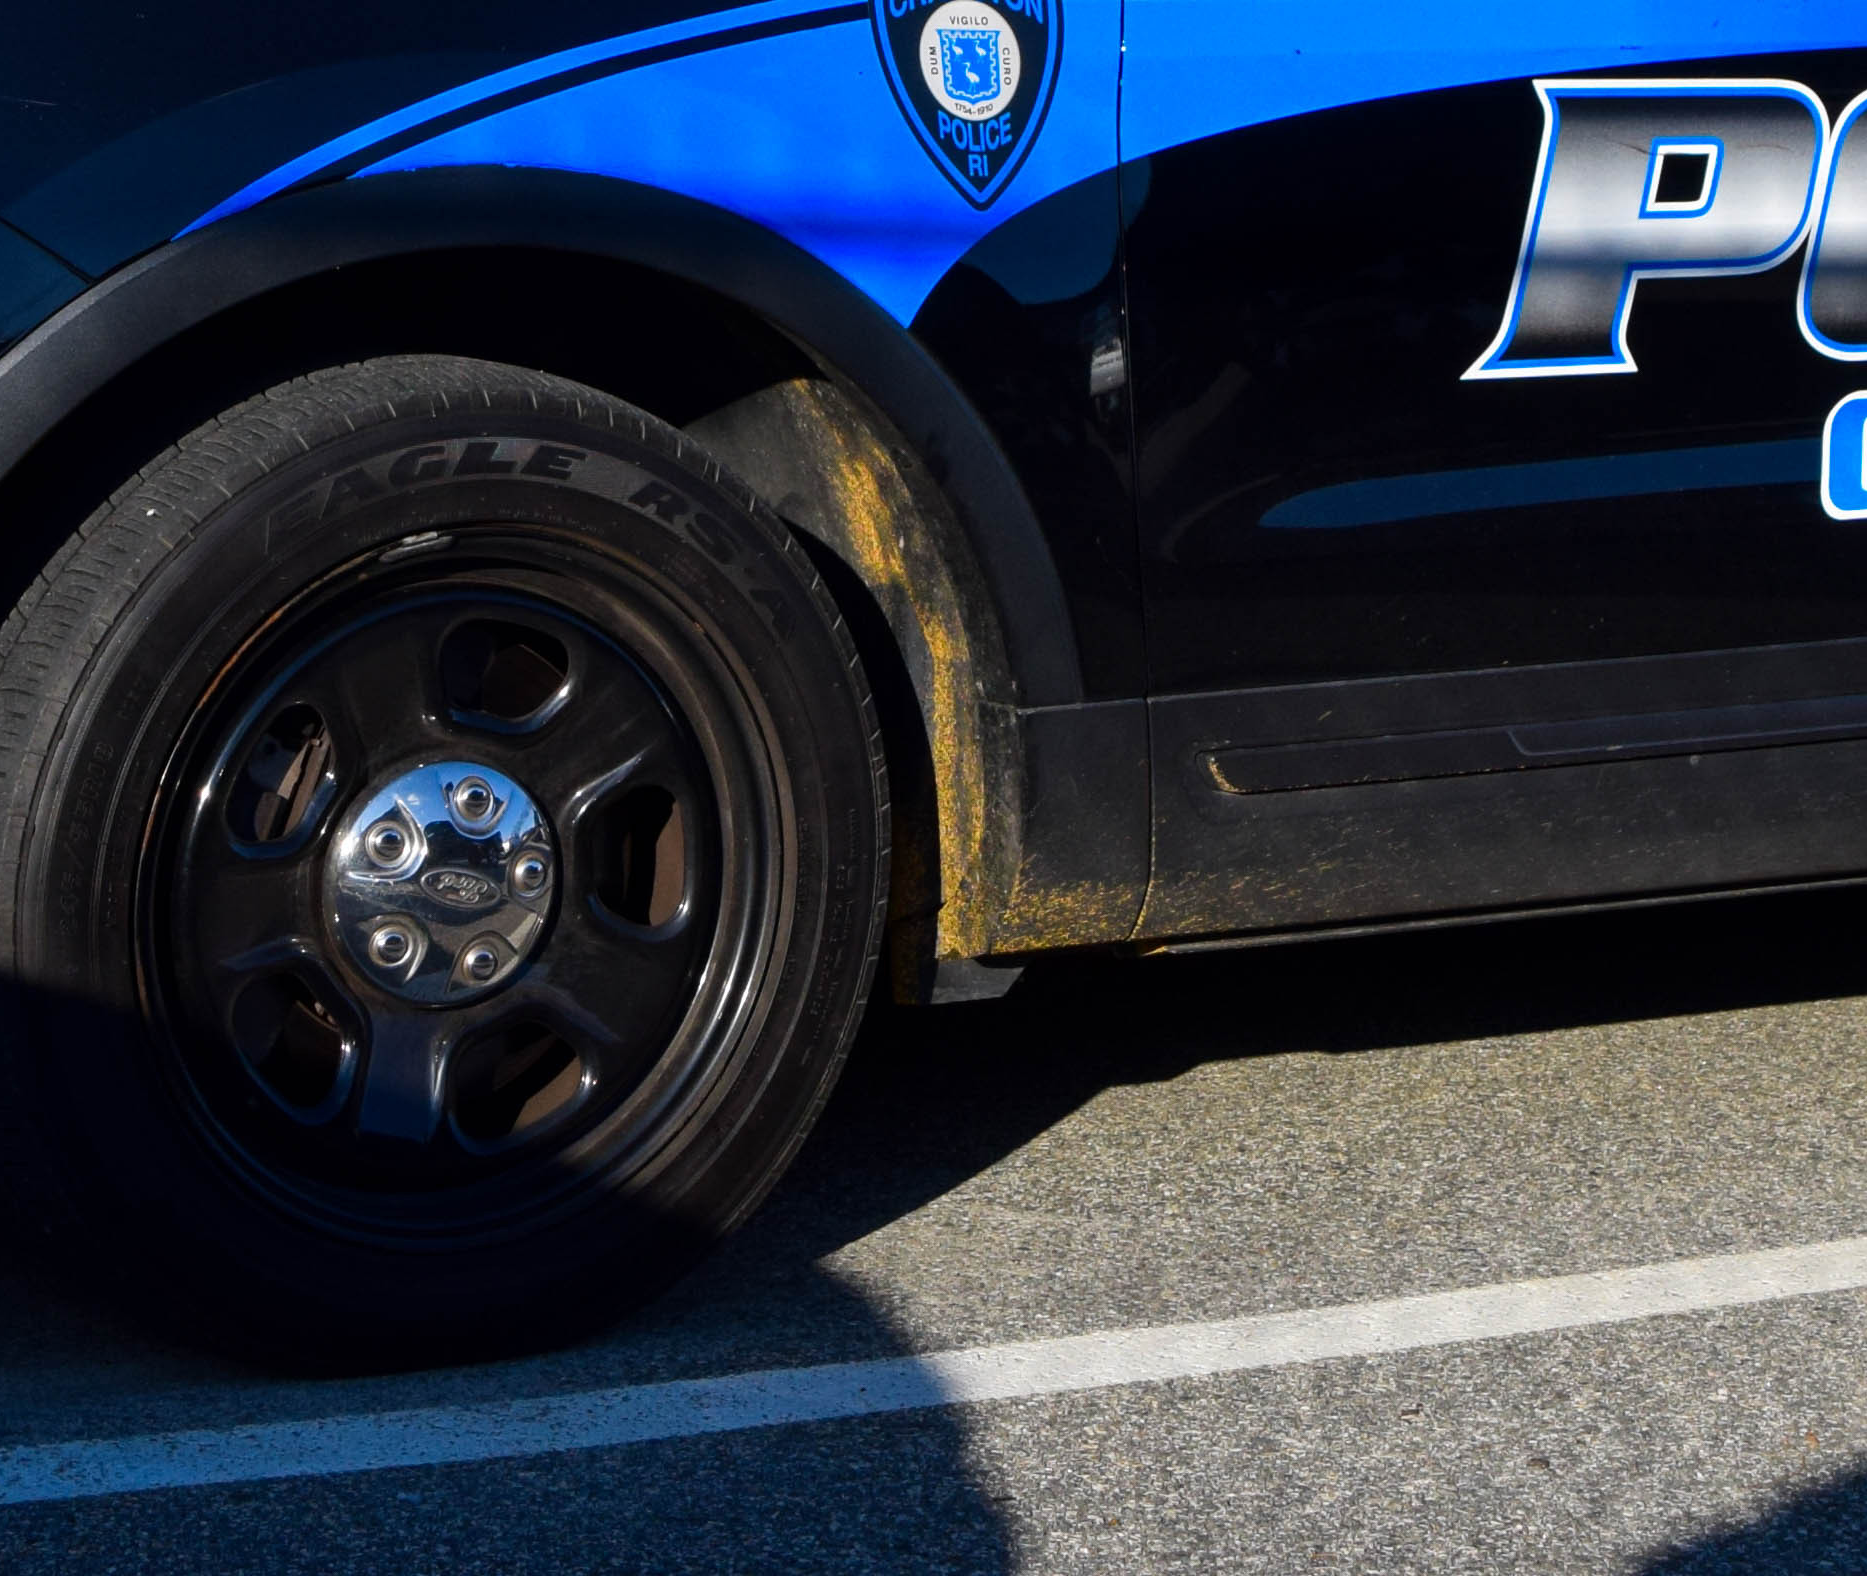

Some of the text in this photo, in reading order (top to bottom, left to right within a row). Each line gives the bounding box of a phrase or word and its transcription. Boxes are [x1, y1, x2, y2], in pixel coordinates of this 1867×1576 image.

[949, 15, 990, 26] VIGILO
[929, 45, 939, 75] DUM
[1001, 47, 1012, 86] CURO
[953, 102, 994, 116] 1754-1910
[937, 109, 1013, 153] POLICE
[967, 153, 989, 177] RI
[265, 441, 587, 551] EAGLE
